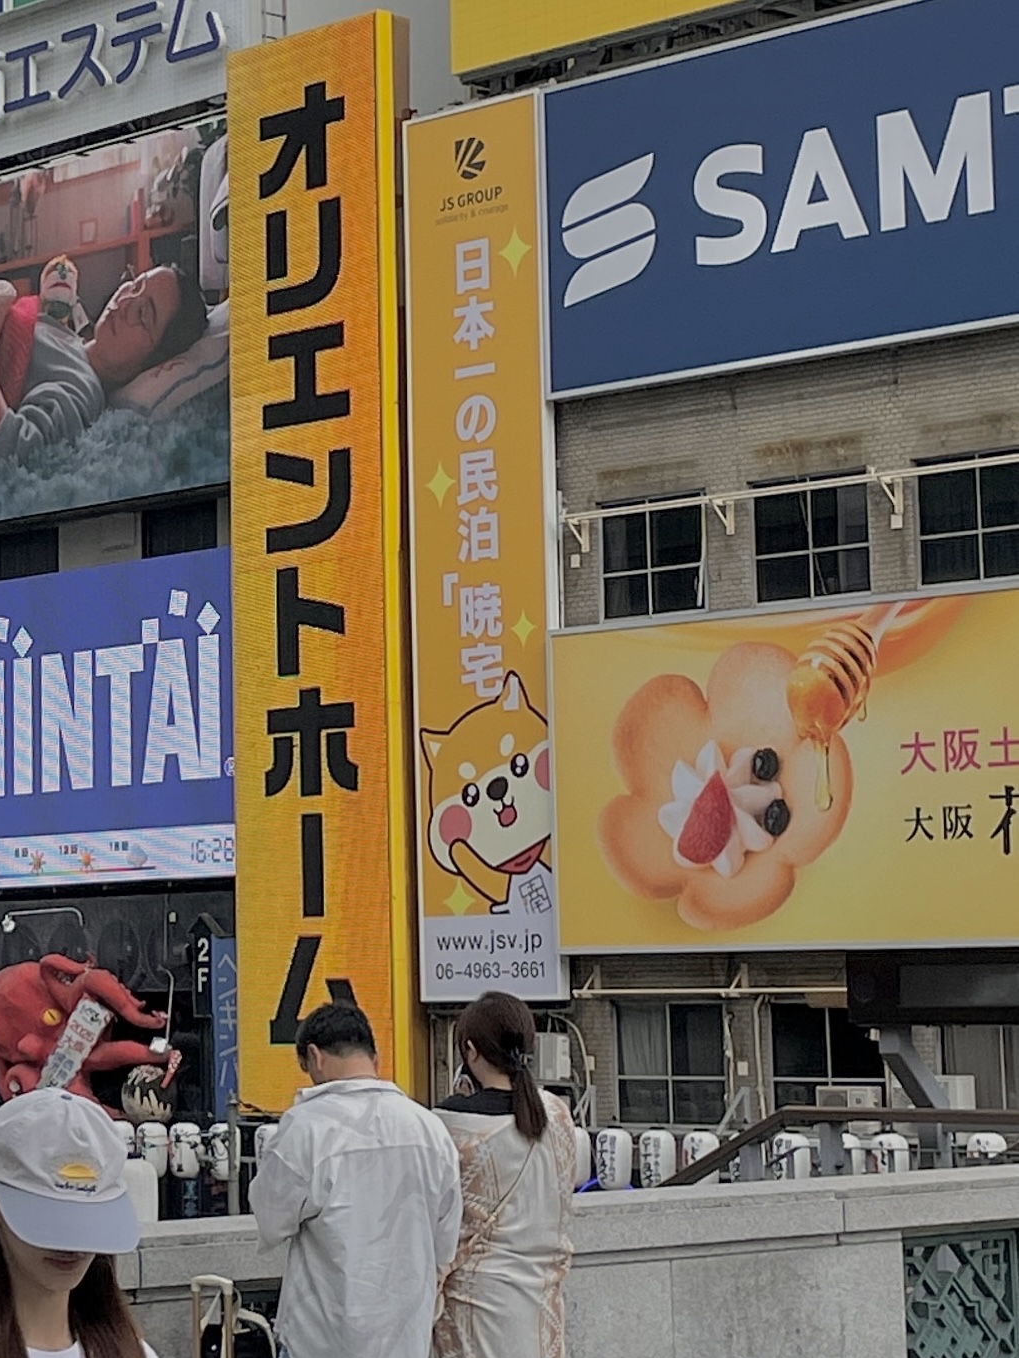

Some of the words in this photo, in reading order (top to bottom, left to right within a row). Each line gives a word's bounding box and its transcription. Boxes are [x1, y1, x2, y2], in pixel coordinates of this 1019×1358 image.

[694, 84, 1019, 266] SAM
[440, 197, 455, 212] JS
[457, 186, 503, 208] GROUP
[259, 81, 359, 1045] オリエントホーム
[437, 928, 542, 954] www.jsv.jp
[435, 960, 546, 980] 06-4963-3661
